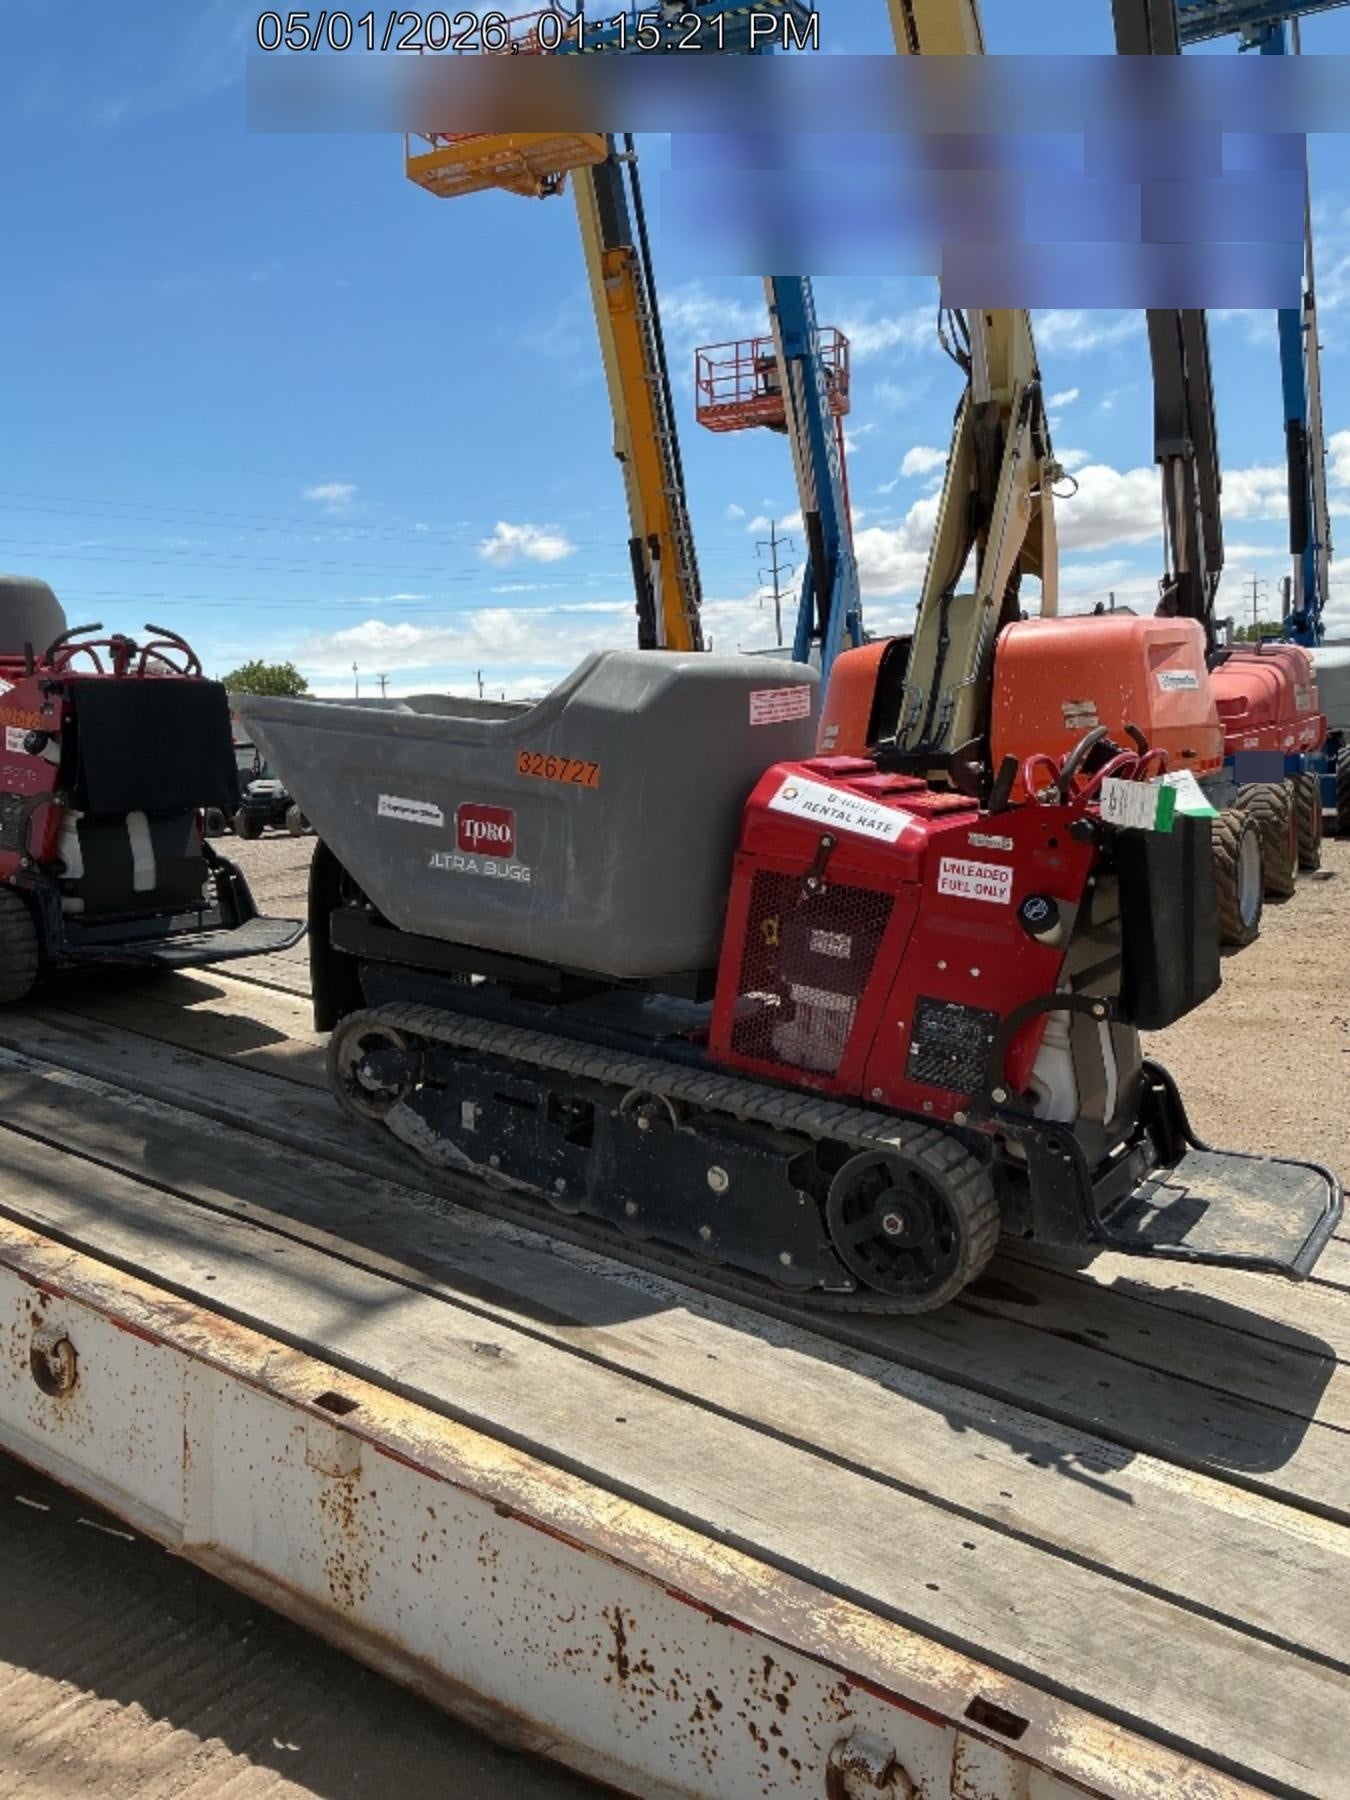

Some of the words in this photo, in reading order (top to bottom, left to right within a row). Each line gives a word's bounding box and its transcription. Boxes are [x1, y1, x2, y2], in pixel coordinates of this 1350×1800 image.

[519, 751, 599, 784] 326727
[801, 800, 852, 823] RENTAL
[856, 815, 893, 833] RATE
[461, 819, 512, 843] TORO
[943, 862, 1009, 883] UNLEADED
[941, 878, 971, 893] FUEL
[974, 883, 1007, 899] ONLY
